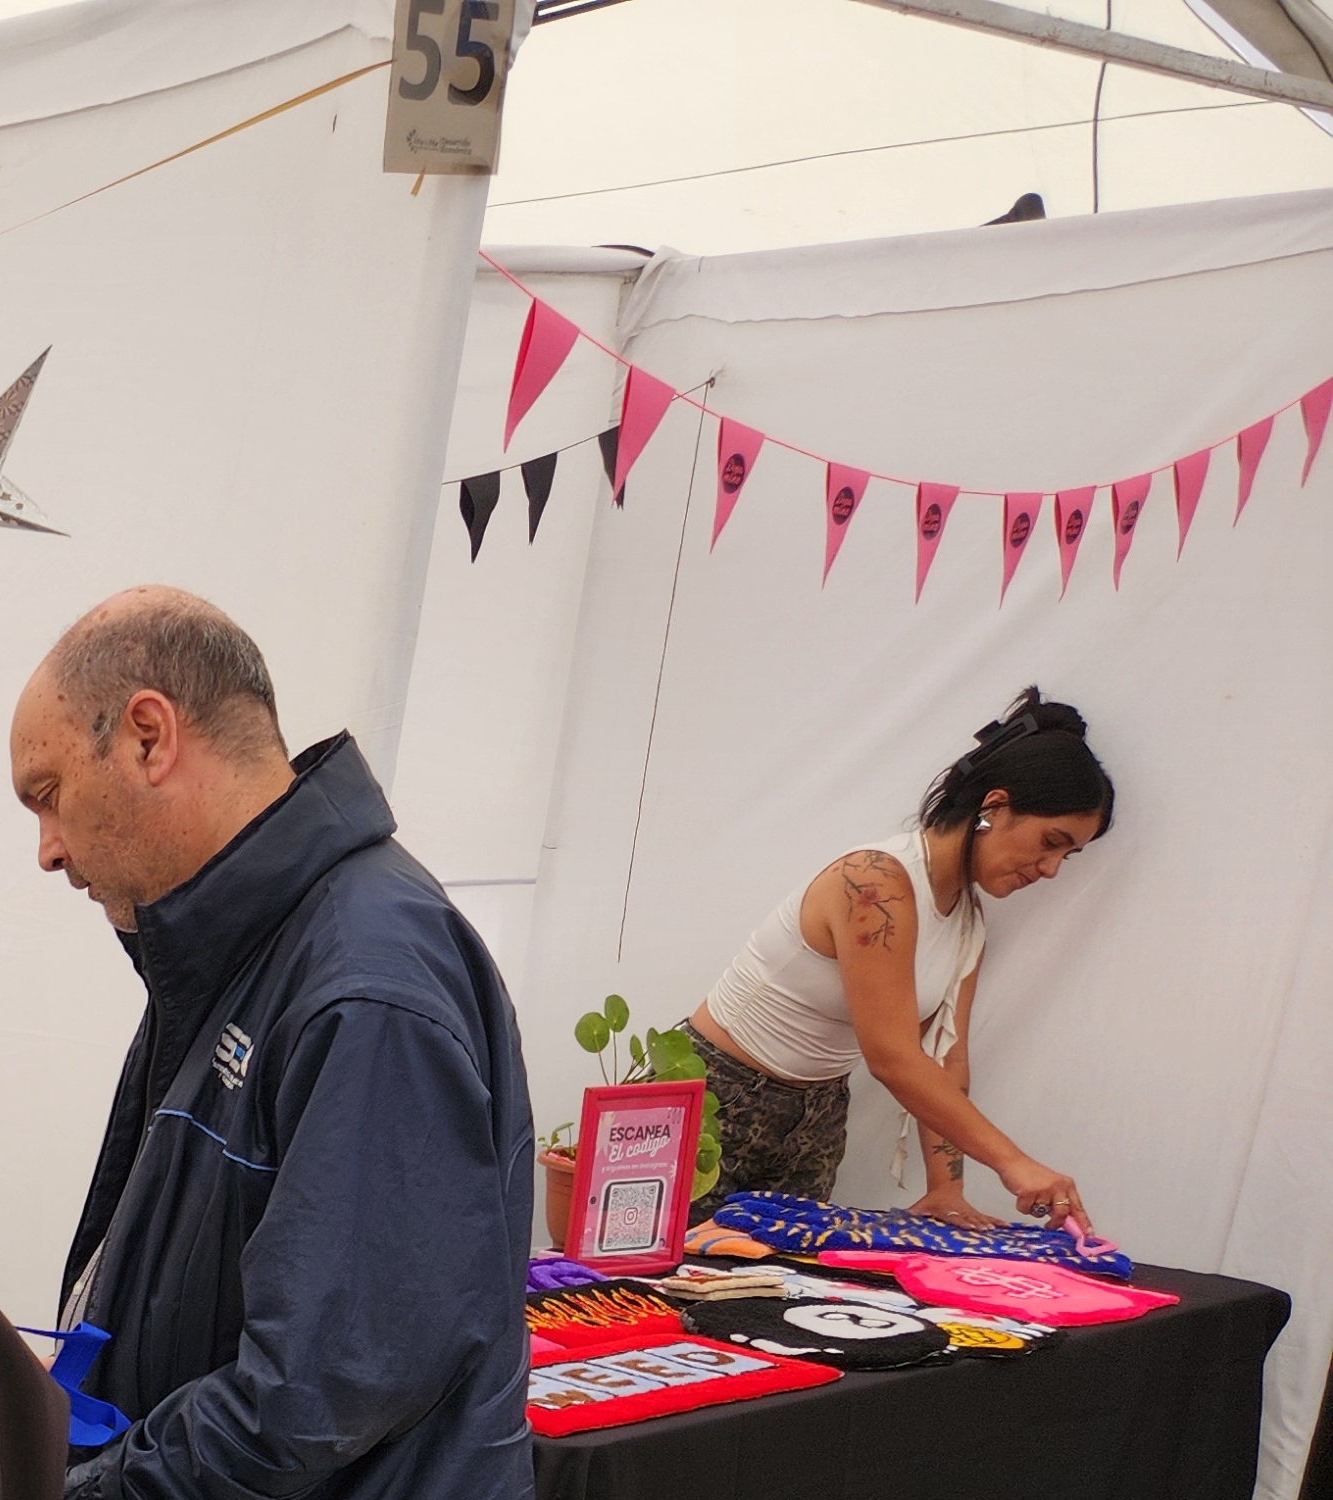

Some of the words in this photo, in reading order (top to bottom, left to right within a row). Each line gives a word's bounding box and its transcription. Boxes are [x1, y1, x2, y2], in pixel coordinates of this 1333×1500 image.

[398, 0, 500, 106] 55
[609, 1124, 671, 1142] ESCANEA
[609, 1143, 624, 1163] El
[626, 1134, 671, 1157] codigo
